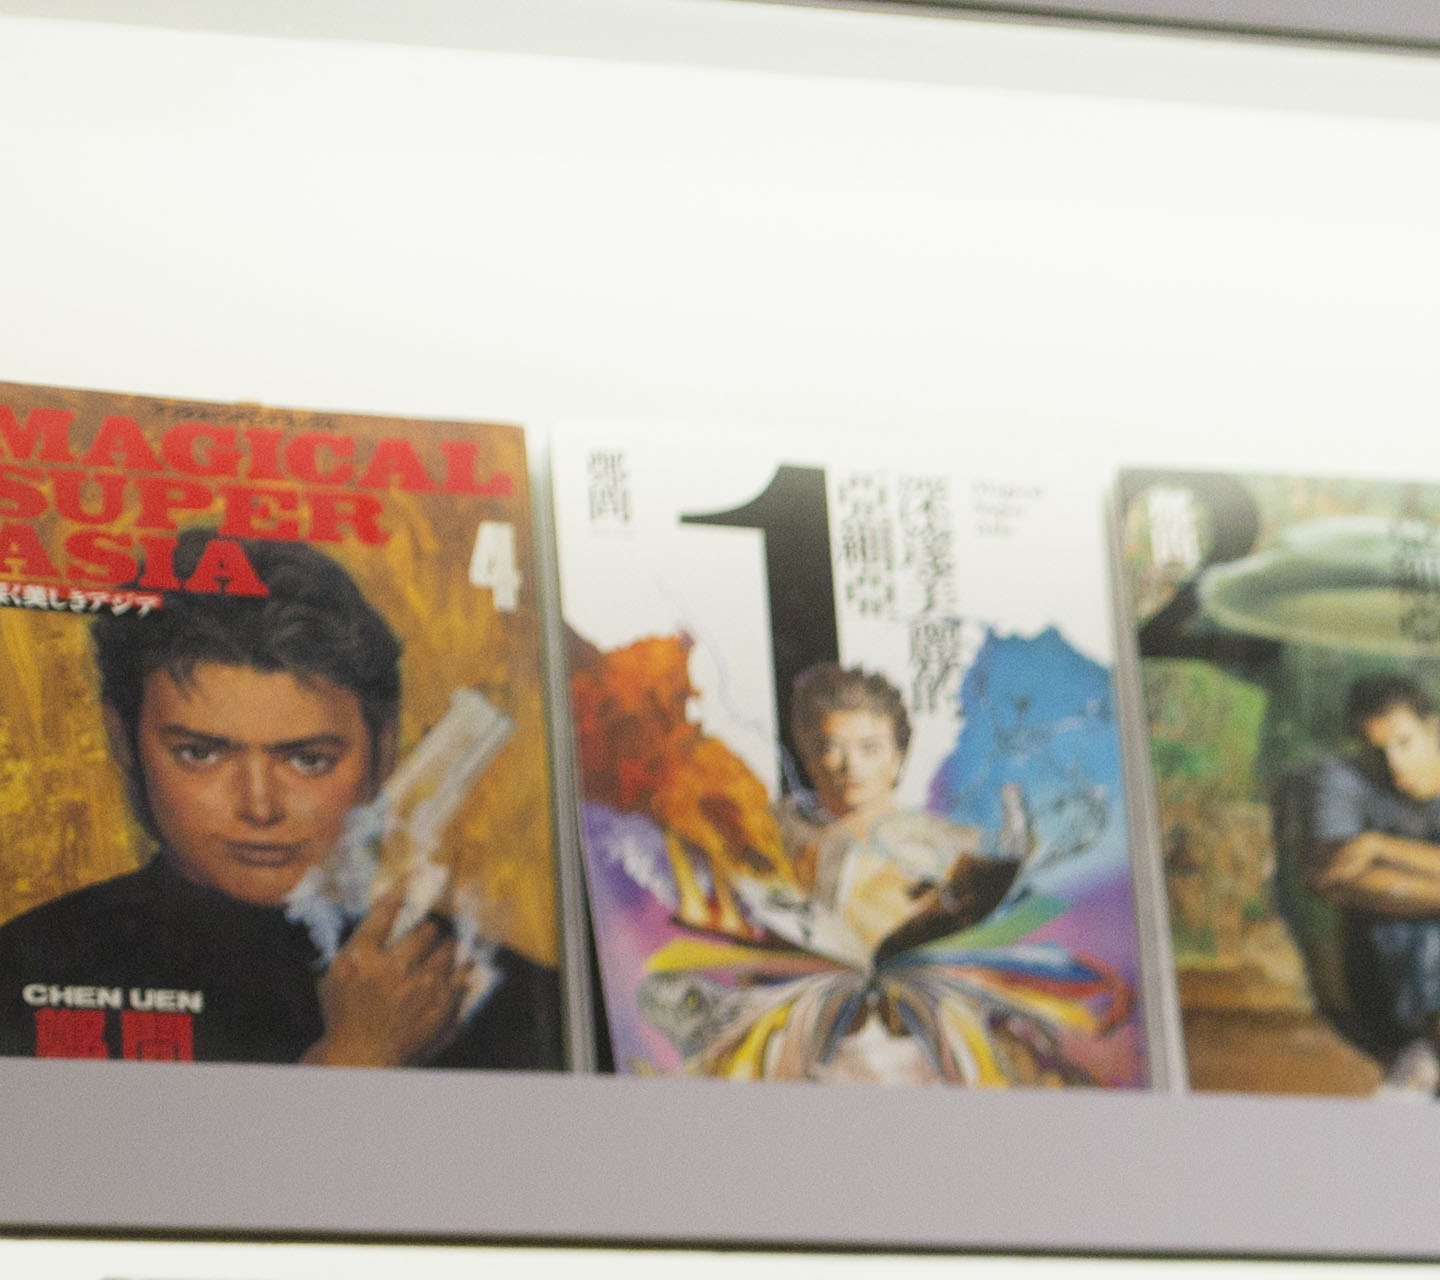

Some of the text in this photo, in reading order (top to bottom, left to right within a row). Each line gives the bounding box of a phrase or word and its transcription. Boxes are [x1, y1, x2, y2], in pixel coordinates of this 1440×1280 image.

[0, 407, 513, 497] MAGICAL
[0, 463, 388, 546] SUPER
[0, 523, 269, 598] ASIA
[469, 520, 519, 612] 4
[680, 463, 840, 800] 1
[22, 983, 204, 1014] CHEN UEN
